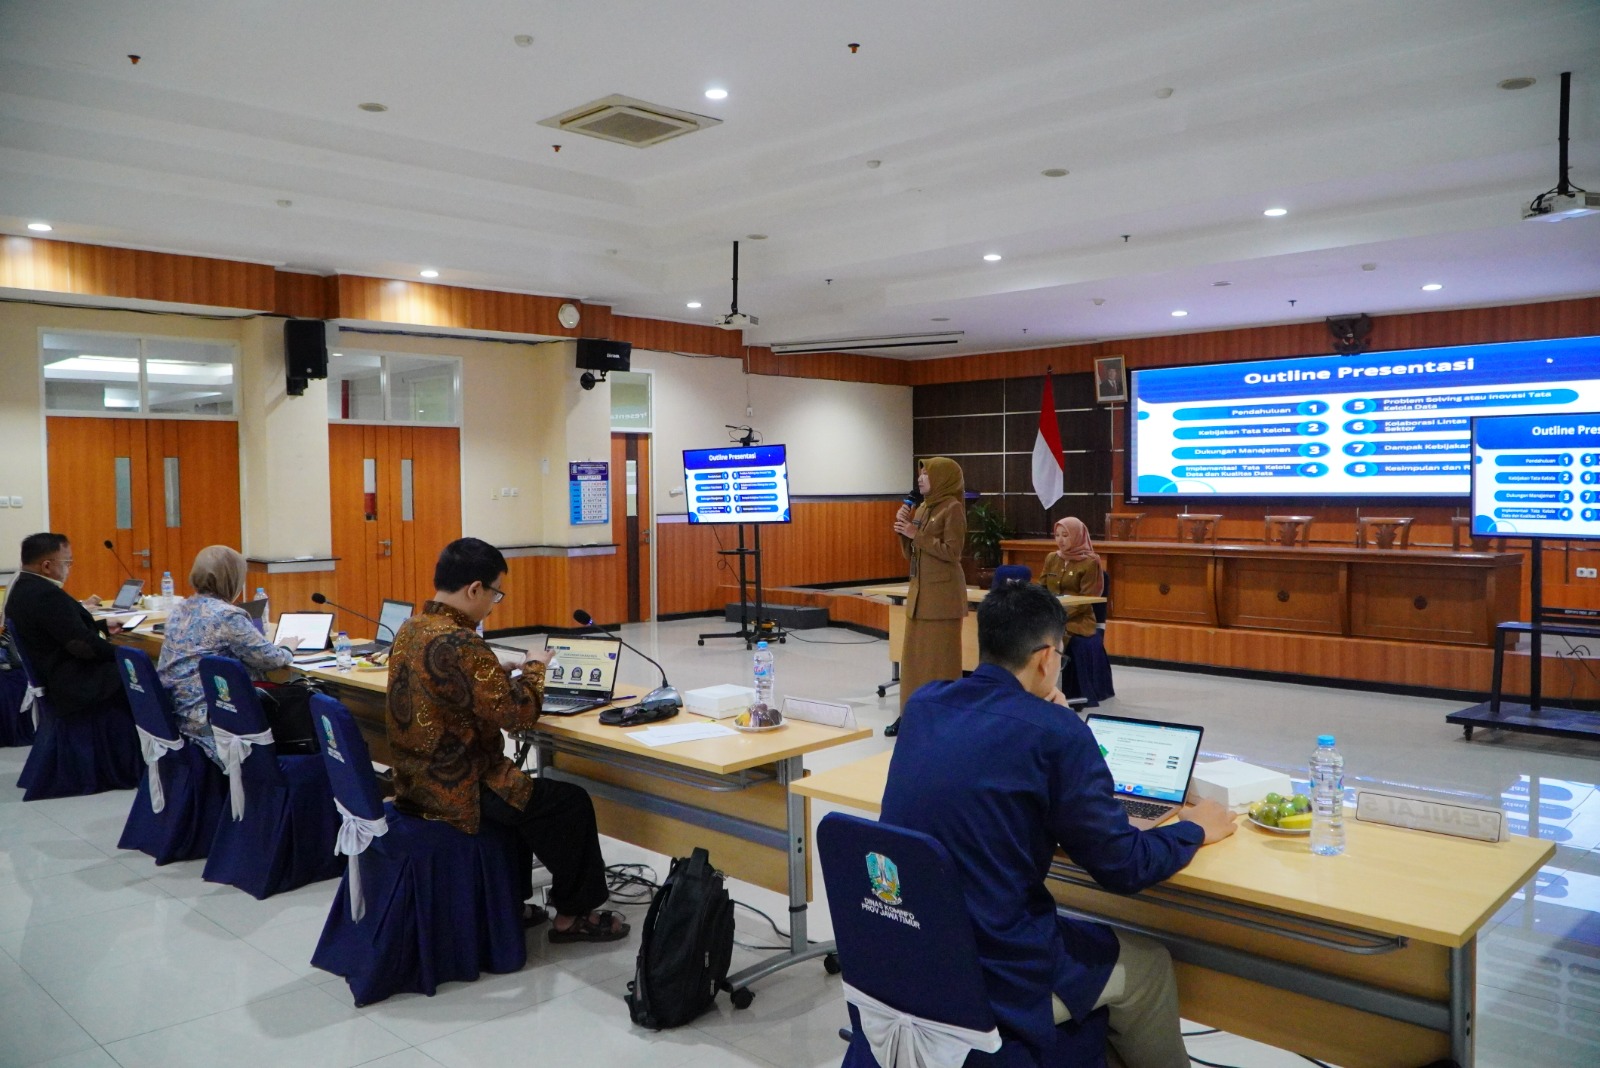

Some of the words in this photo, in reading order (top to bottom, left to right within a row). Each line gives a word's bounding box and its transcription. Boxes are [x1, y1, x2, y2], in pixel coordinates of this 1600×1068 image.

[1244, 370, 1331, 384] Outline
[1338, 358, 1474, 379] Presentasi
[1384, 397, 1424, 405] Problem
[1426, 394, 1462, 404] Solving
[1488, 392, 1526, 400] Inovasi
[1308, 404, 1318, 413] 1
[1354, 402, 1365, 410] 5
[1232, 407, 1291, 416] Pendahuluan
[1308, 423, 1319, 432] 2
[1353, 422, 1364, 430] 6
[1532, 425, 1575, 436] Outline
[1309, 446, 1320, 454] 3
[1352, 444, 1364, 452] 7
[1307, 465, 1318, 473] 4
[1354, 464, 1366, 473] 8
[864, 898, 883, 909] DINAS
[884, 904, 914, 920] KOMINFO
[861, 903, 879, 914] PROV
[880, 907, 898, 922] JAWA
[899, 915, 920, 930] TIMUR
